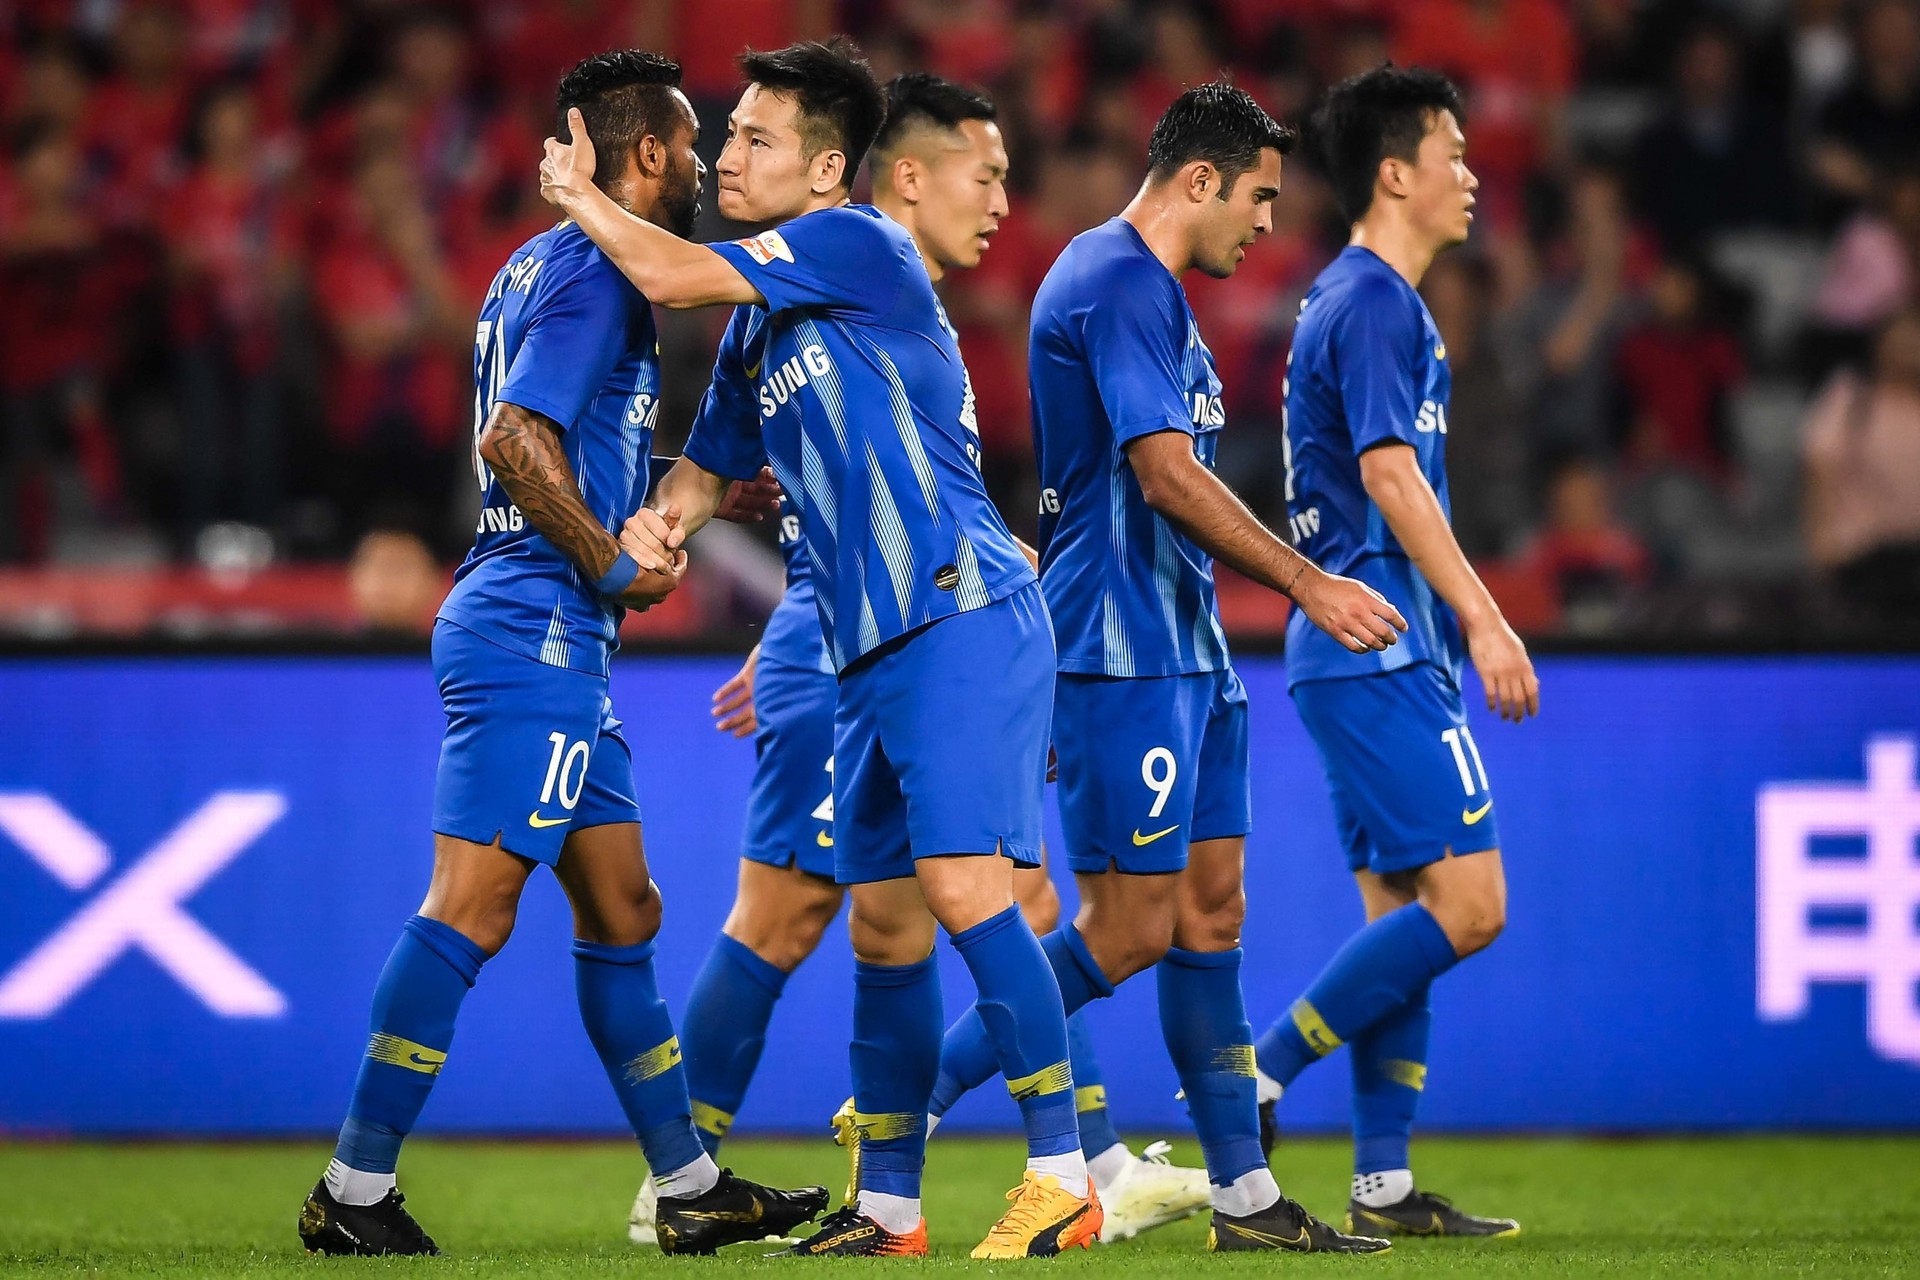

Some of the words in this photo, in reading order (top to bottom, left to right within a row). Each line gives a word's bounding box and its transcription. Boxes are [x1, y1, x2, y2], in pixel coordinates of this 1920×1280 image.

[540, 731, 590, 810] 10
[1141, 747, 1177, 818] 9
[1441, 725, 1489, 796] 11
